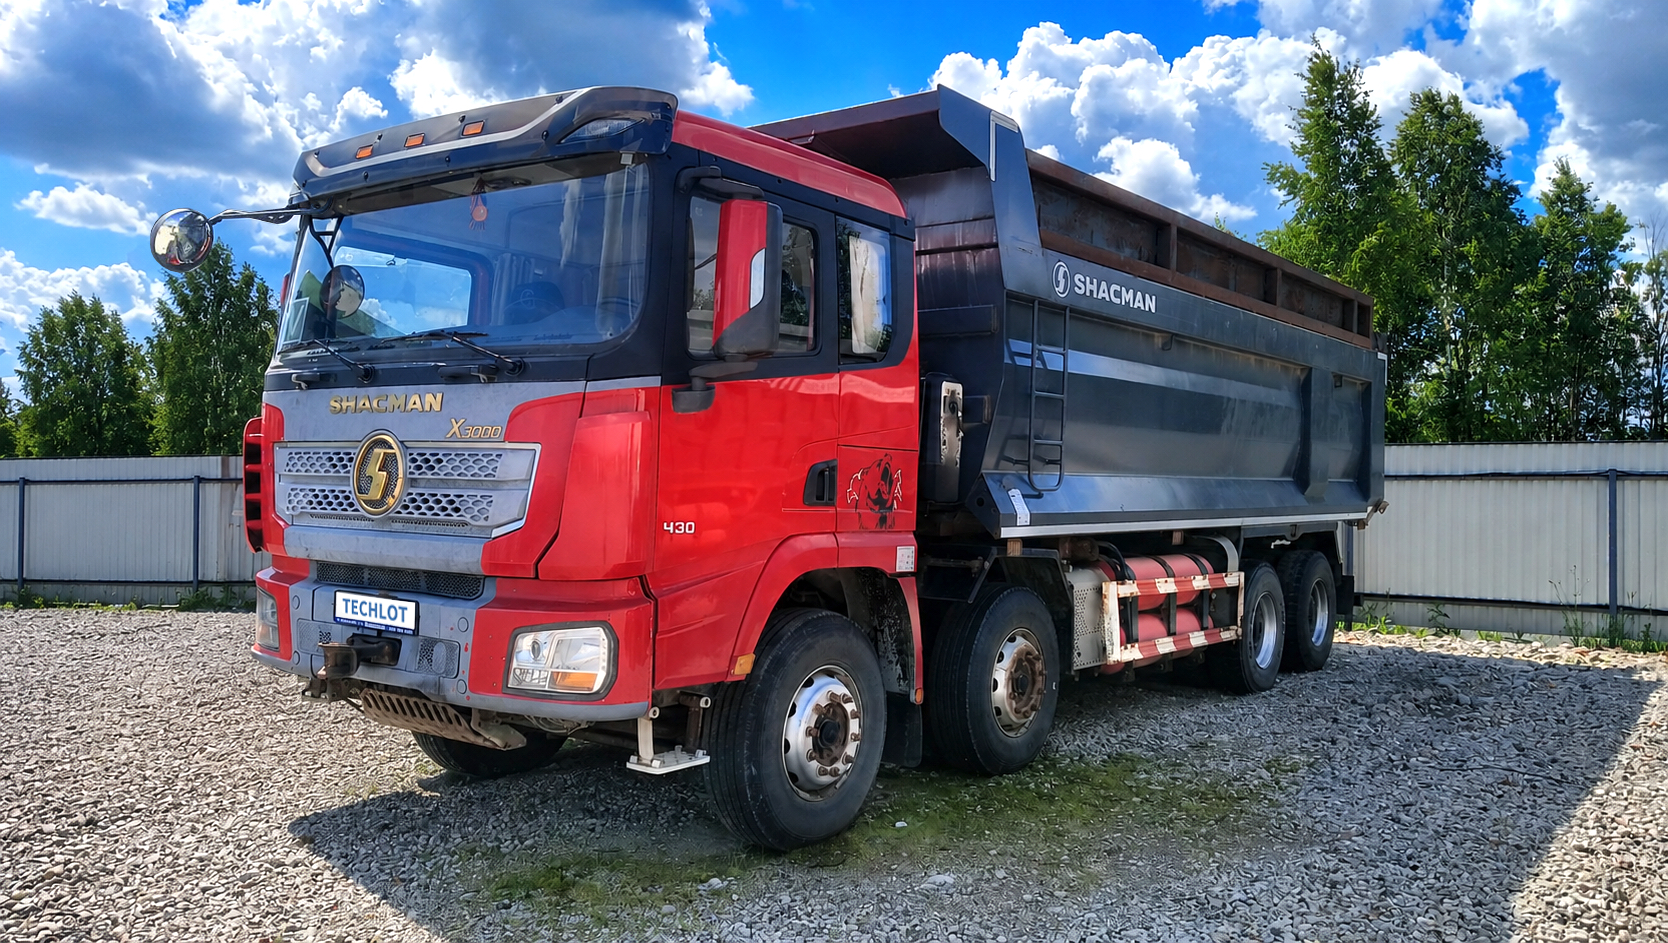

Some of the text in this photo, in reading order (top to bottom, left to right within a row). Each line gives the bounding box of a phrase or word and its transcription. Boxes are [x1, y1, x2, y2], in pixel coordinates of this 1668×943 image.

[1073, 273, 1156, 313] SHACMAN
[329, 392, 443, 414] SHACMAN
[446, 418, 502, 439] X3000
[663, 521, 695, 534] 430
[342, 598, 408, 623] TECHLOT
